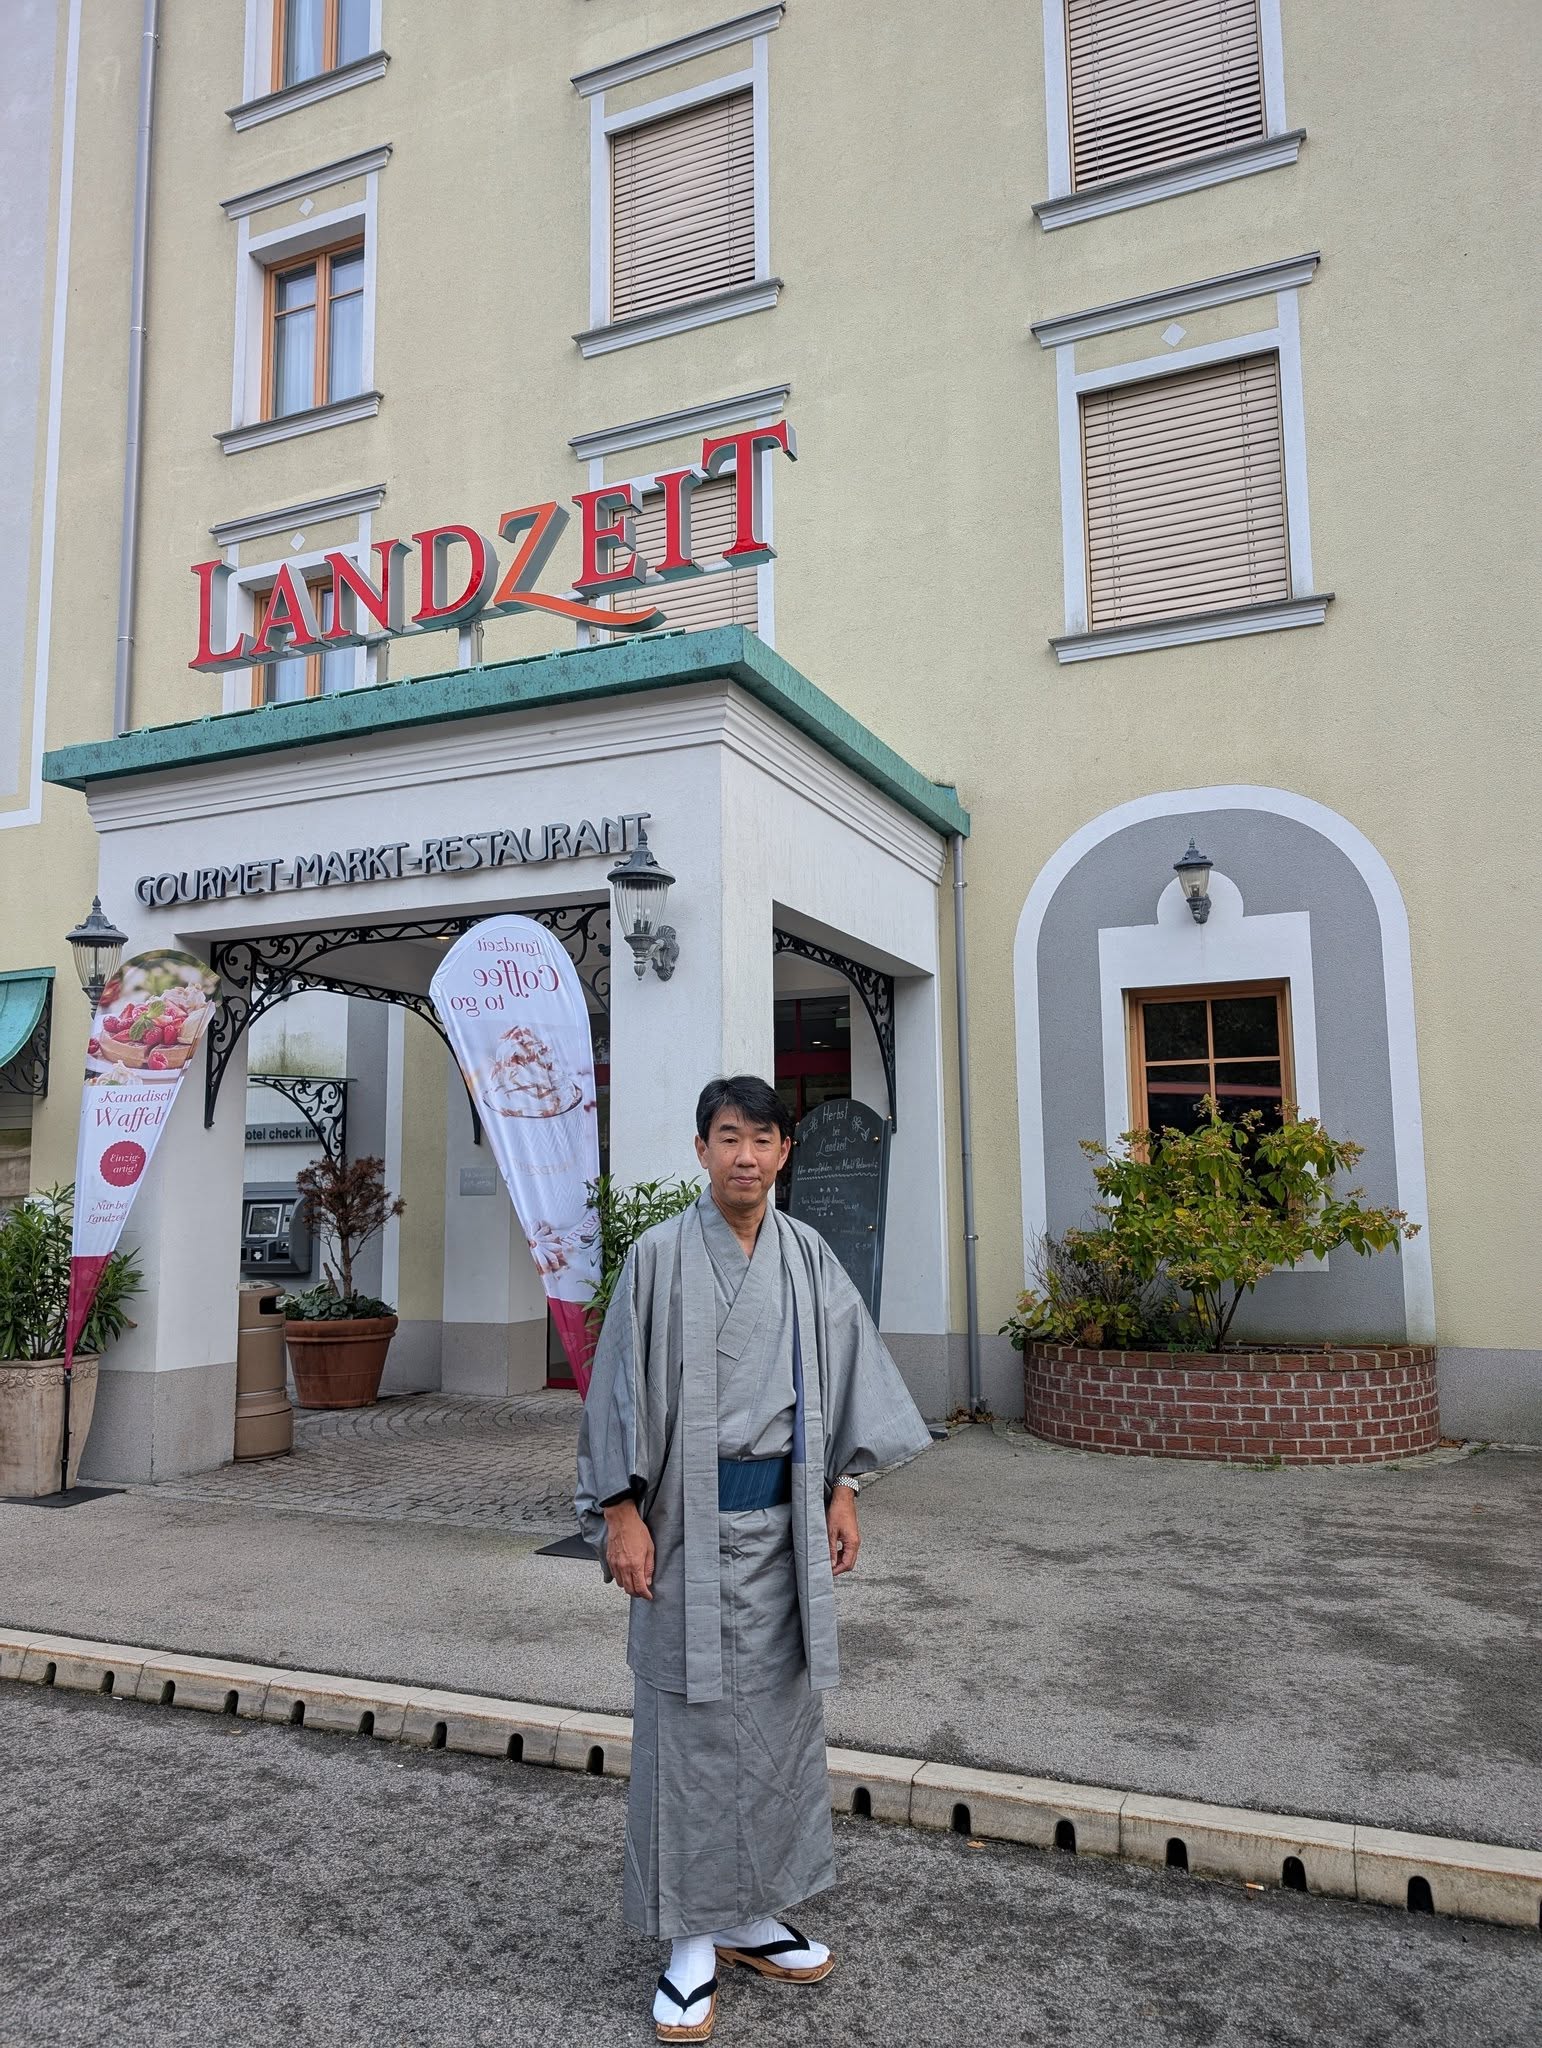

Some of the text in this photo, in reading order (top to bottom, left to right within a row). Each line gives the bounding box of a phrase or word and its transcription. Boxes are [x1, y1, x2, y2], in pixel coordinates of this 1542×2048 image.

[188, 420, 797, 673] LANDZEIT
[134, 812, 651, 906] GOURMET-MARKT-RESTAURANT
[822, 1101, 849, 1124] Herbst
[245, 1126, 316, 1140] otel check in
[109, 1153, 141, 1164] Einzig-
[112, 1163, 138, 1176] artig!
[92, 1200, 115, 1211] Nur
